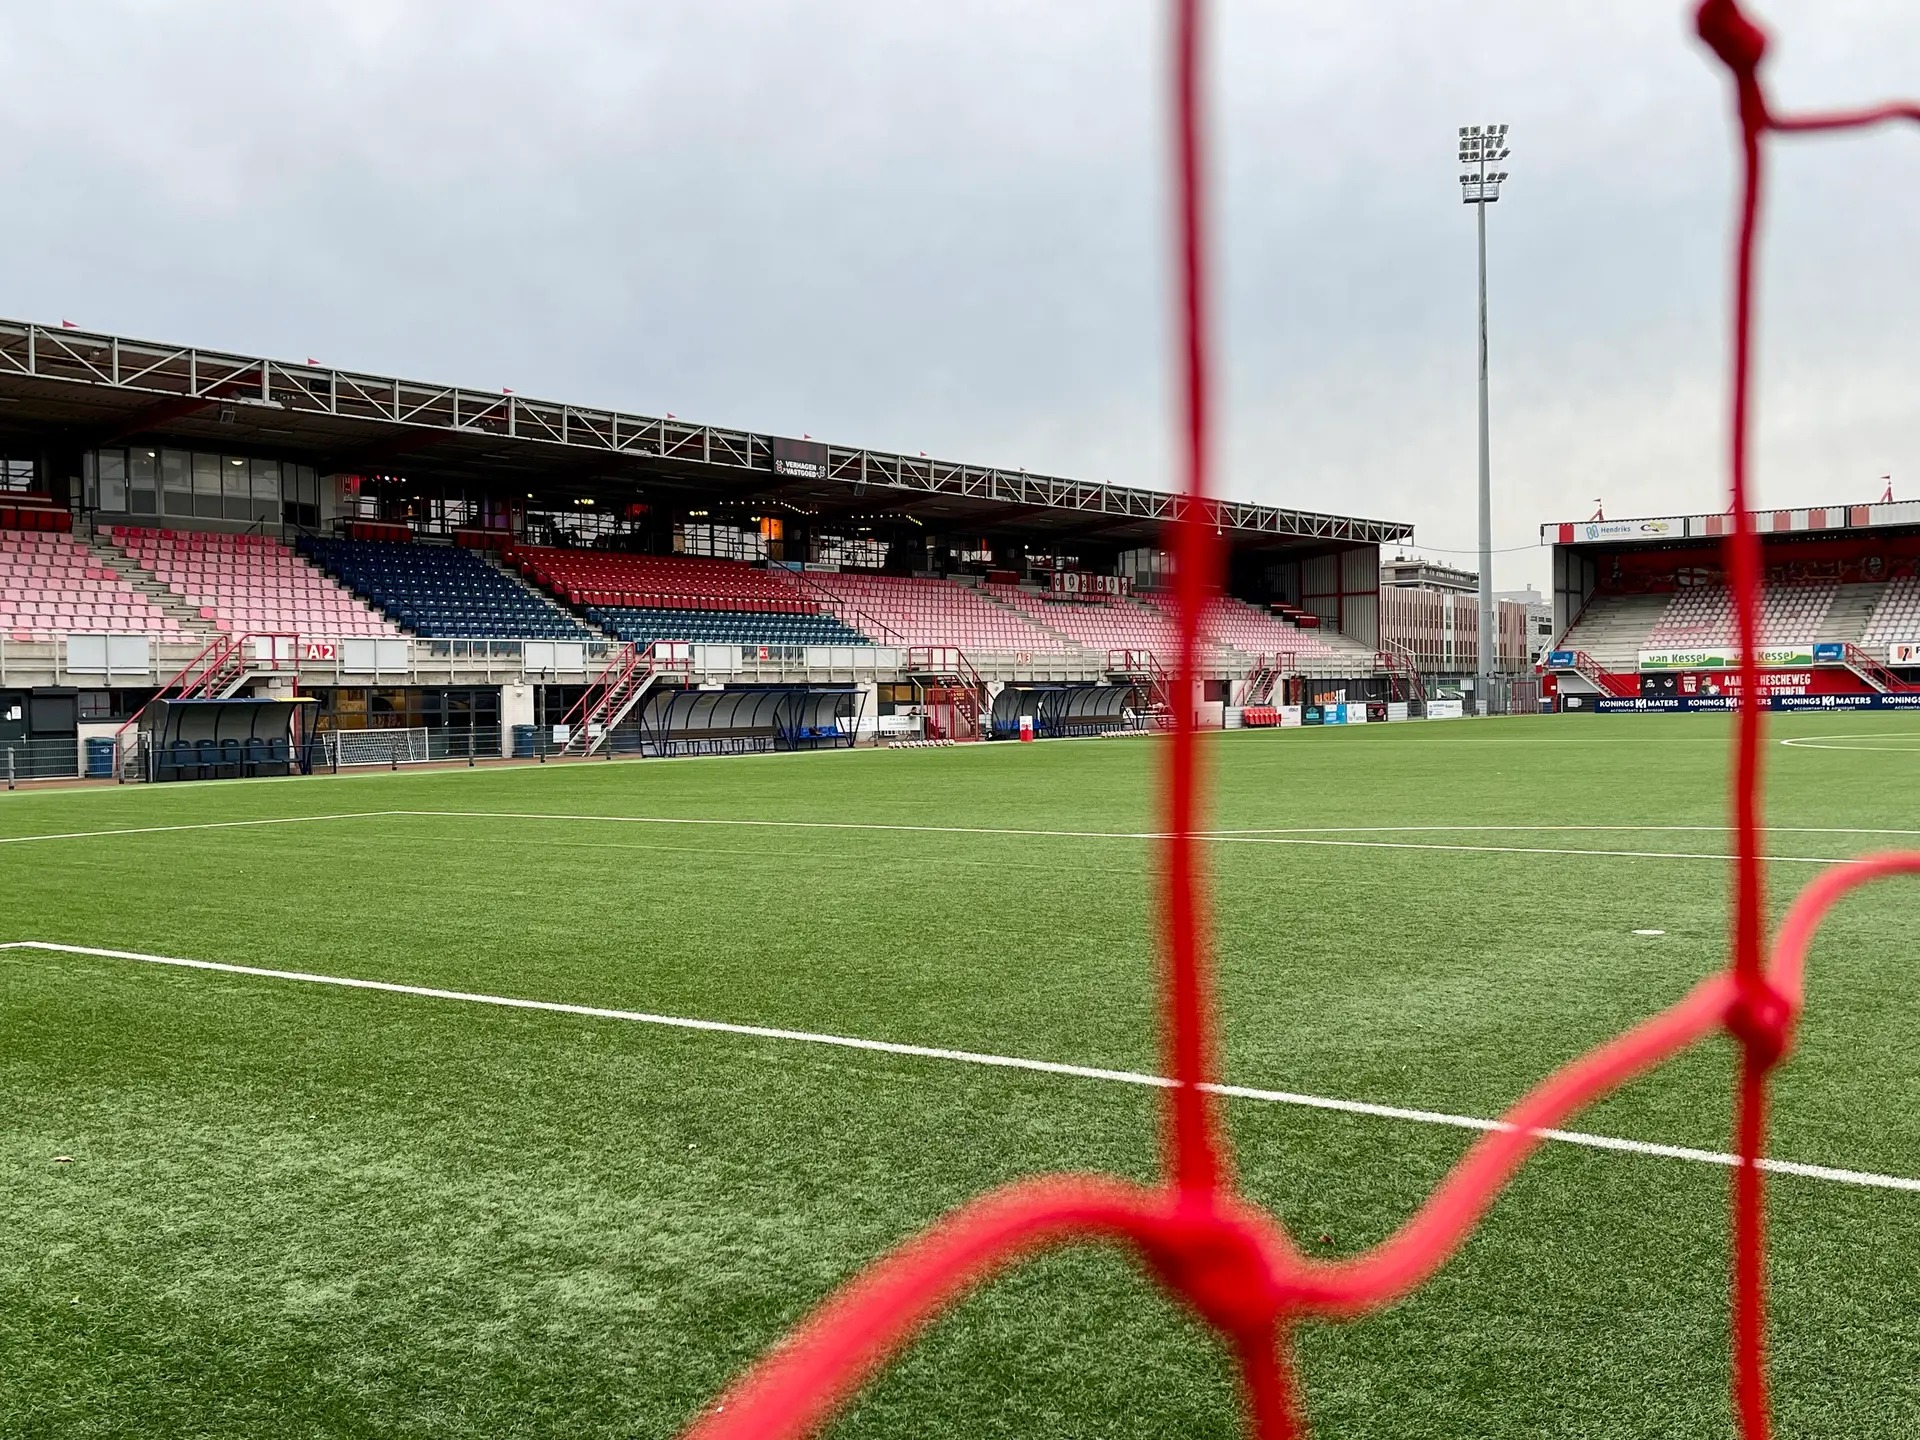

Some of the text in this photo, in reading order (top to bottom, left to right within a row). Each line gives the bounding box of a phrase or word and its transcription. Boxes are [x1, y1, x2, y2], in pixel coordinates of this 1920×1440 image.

[785, 461, 817, 471] VERHAGEN
[786, 468, 817, 478] VASTGOED
[308, 645, 334, 660] A2
[1758, 651, 1793, 661] Kessel
[1672, 653, 1706, 663] Kessel
[1760, 674, 1811, 685] HESCHEWEG
[1688, 699, 1725, 707] KONINGS
[1781, 698, 1821, 706] KONINGS
[1836, 697, 1872, 705] MATERS
